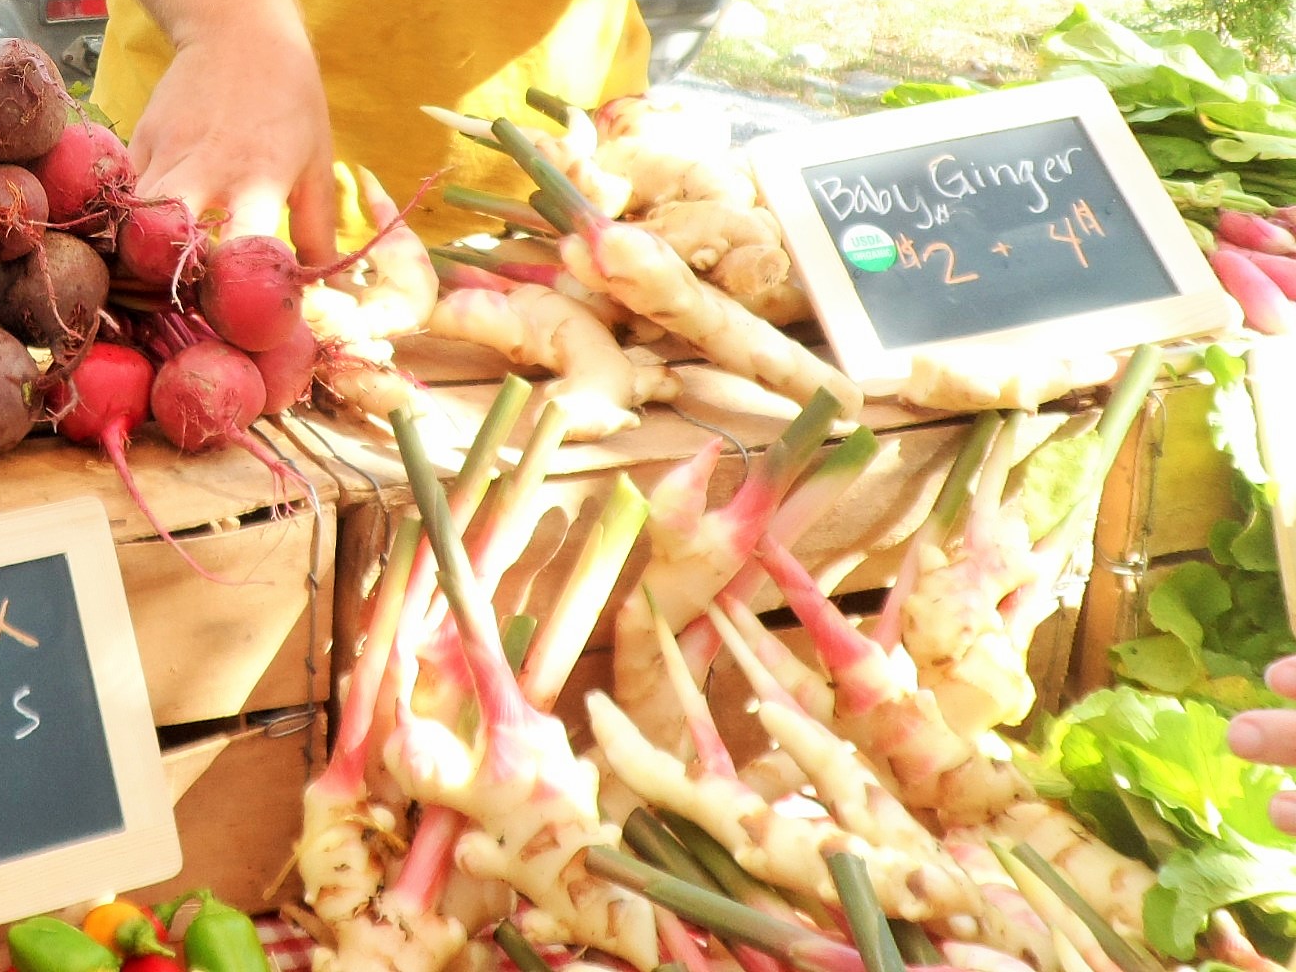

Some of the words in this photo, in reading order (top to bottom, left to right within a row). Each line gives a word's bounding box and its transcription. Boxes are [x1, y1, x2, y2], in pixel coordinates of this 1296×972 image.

[814, 175, 934, 230] Baby
[929, 146, 1082, 215] Ginger
[850, 234, 884, 248] USDA
